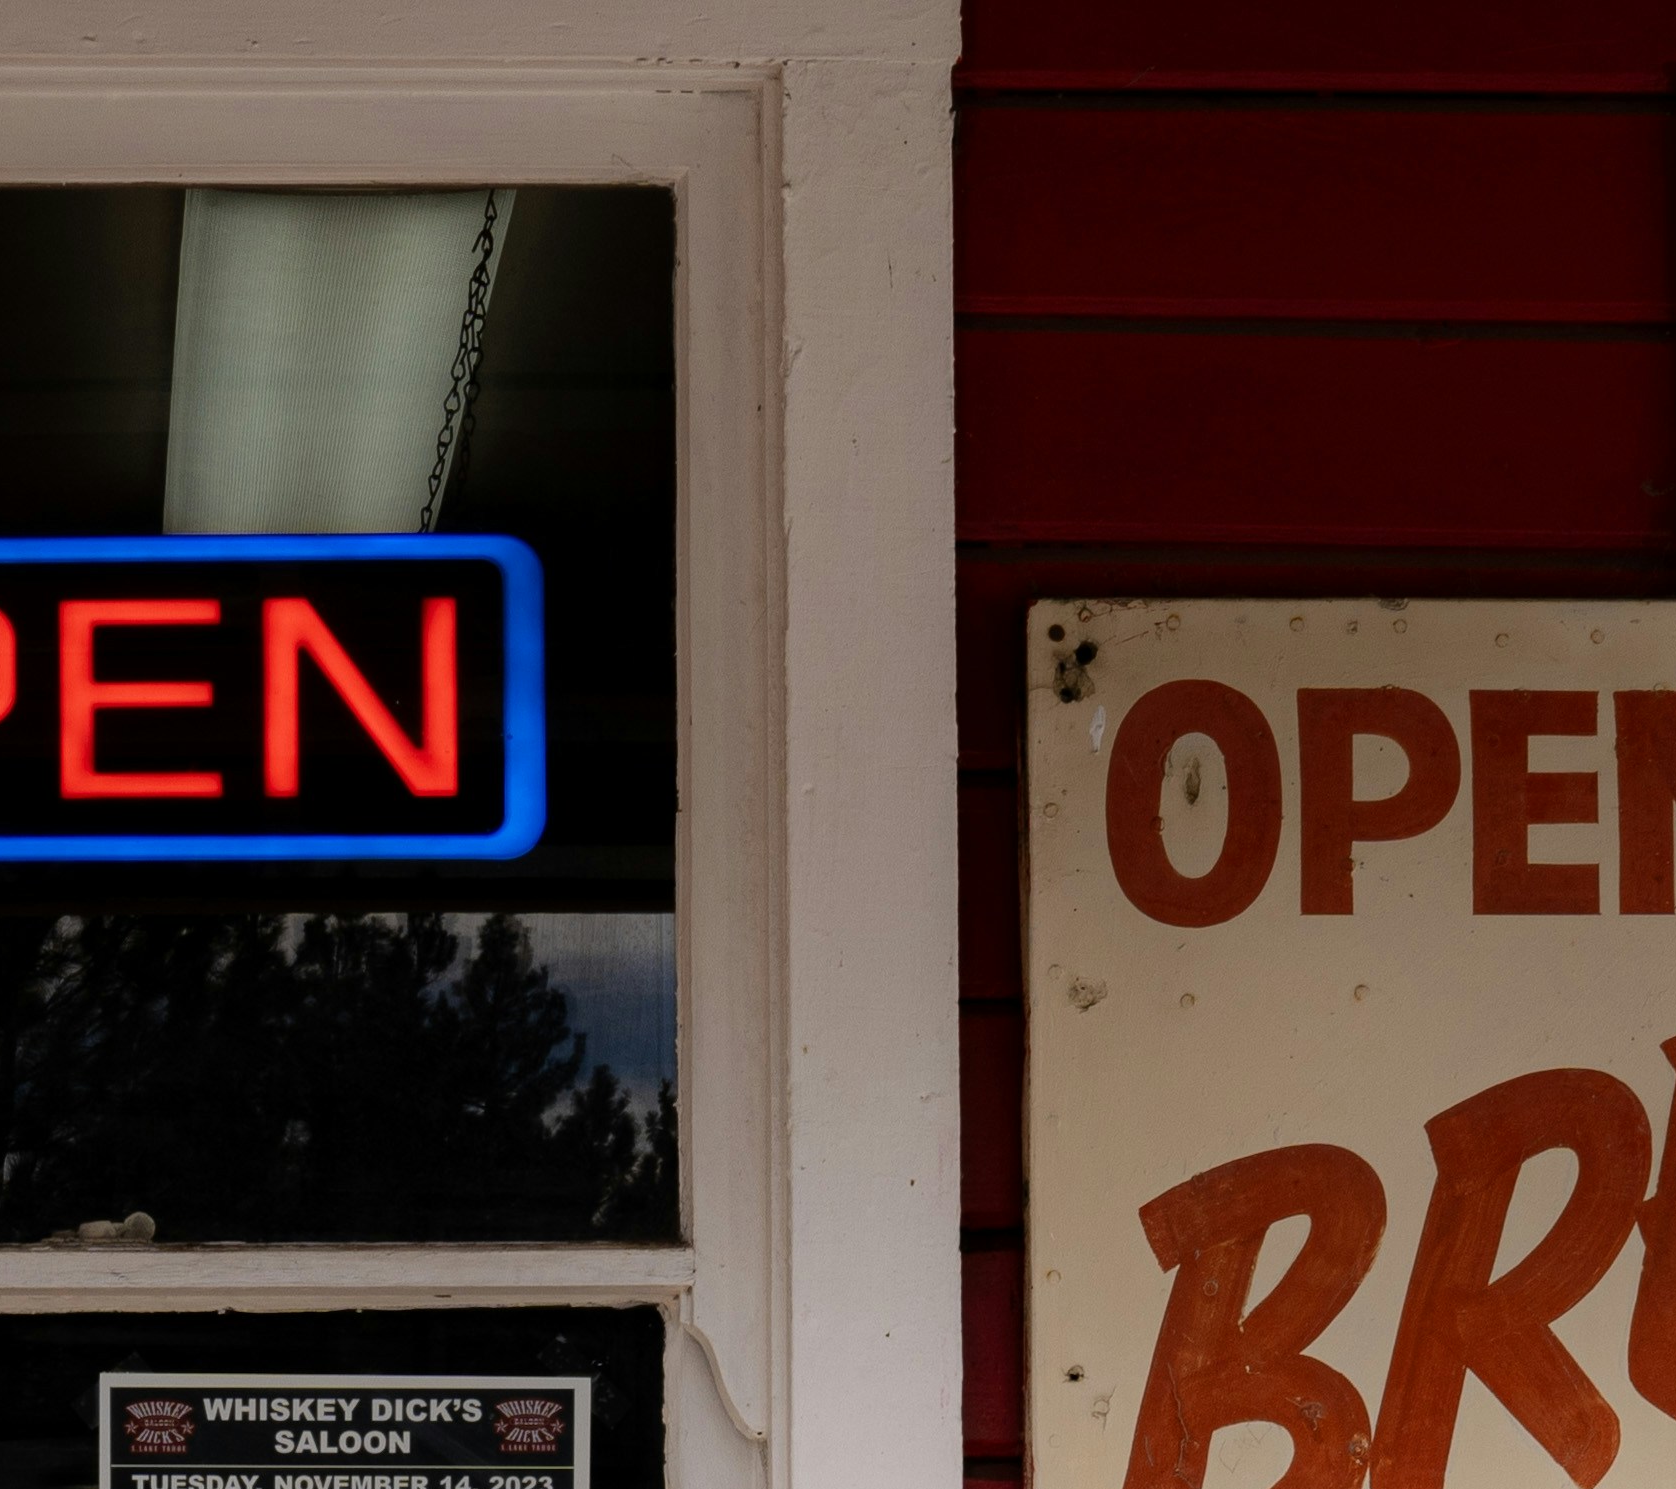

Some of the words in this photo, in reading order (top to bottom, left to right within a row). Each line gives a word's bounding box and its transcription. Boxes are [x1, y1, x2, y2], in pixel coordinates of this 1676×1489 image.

[126, 1400, 193, 1420] WHISKEY
[203, 1398, 358, 1422] WHISKEY
[372, 1398, 483, 1422] DICK'S
[496, 1399, 562, 1419] WHISKEY
[274, 1430, 411, 1455] SALOON
